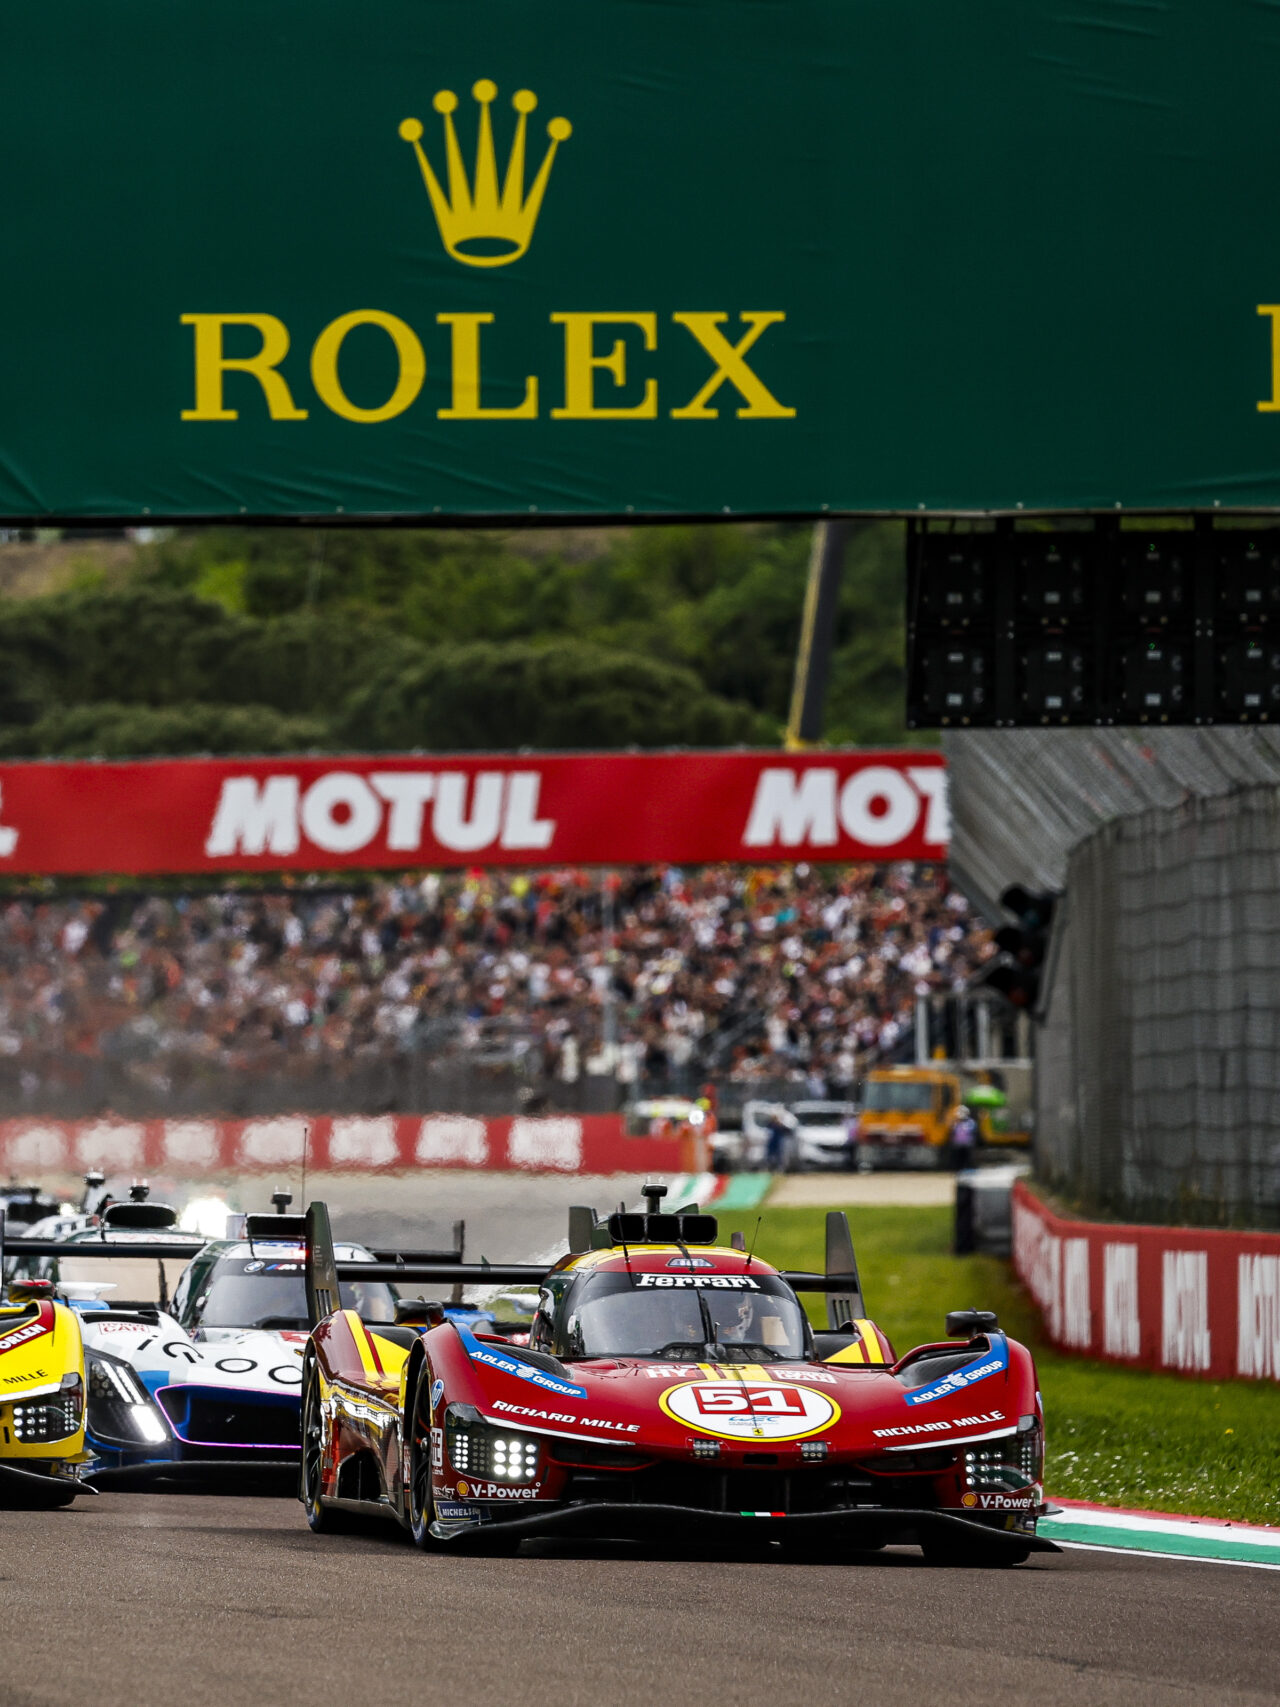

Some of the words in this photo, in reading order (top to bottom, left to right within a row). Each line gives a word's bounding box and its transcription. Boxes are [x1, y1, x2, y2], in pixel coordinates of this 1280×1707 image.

[181, 310, 796, 423] ROLEX
[206, 771, 555, 857] MOTUL
[743, 766, 950, 847] MOT
[636, 1273, 761, 1289] Ferrari
[3, 1369, 48, 1385] MILLE
[469, 1351, 518, 1373] ADLER
[531, 1375, 582, 1396] GROUP
[912, 1382, 955, 1404] ADLER
[965, 1360, 1003, 1381] GROUP
[699, 1389, 801, 1413] 51
[492, 1400, 577, 1424] RICHARD
[580, 1417, 641, 1433] MILLE
[872, 1421, 952, 1438] RICHARD
[952, 1410, 1006, 1427] MILLE
[471, 1484, 540, 1498] V-Power
[980, 1495, 1032, 1509] V-Power
